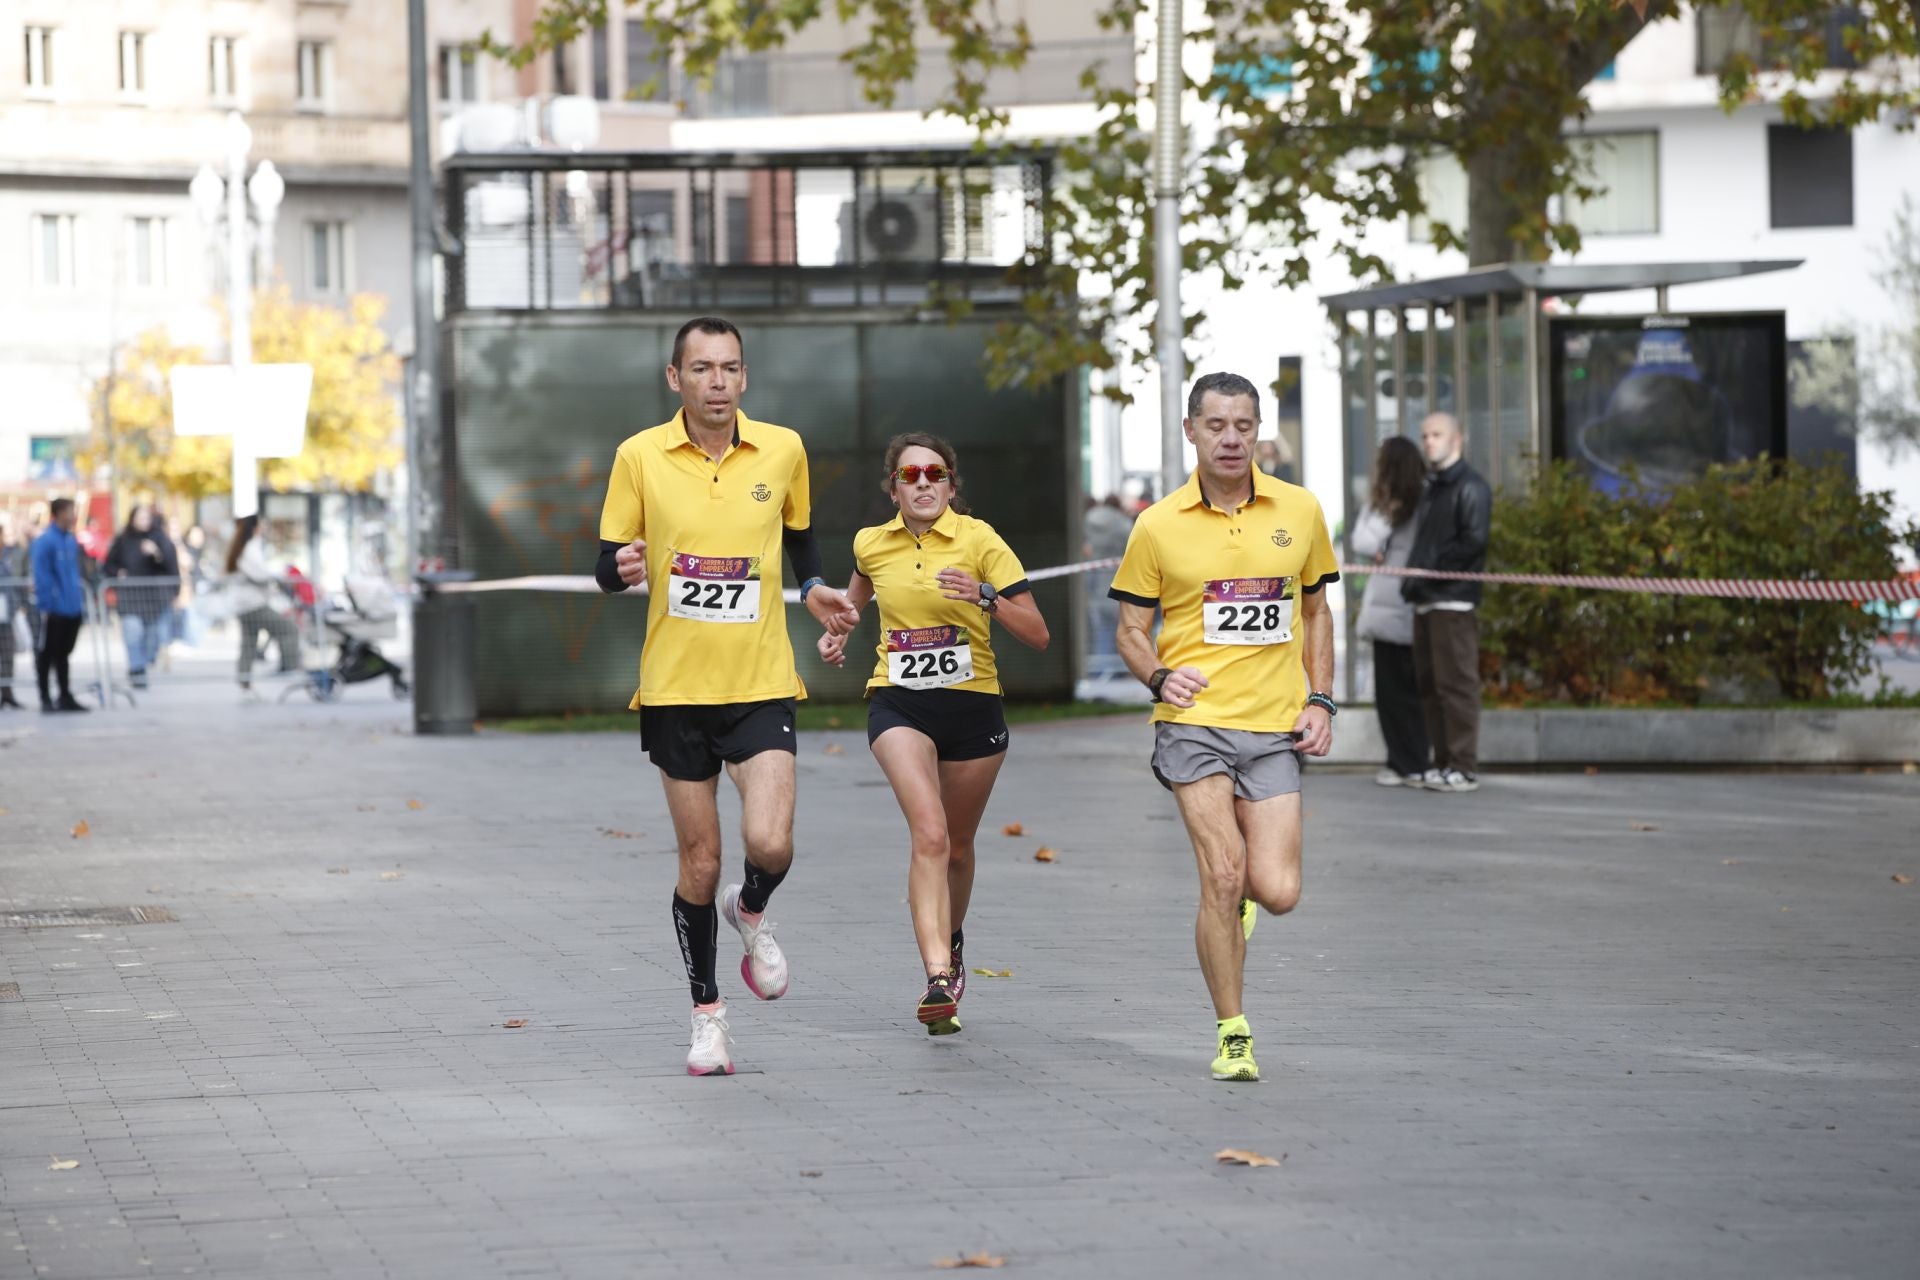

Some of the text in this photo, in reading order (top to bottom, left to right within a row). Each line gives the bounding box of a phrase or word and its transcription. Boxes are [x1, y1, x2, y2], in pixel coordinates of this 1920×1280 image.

[700, 565, 733, 573] EMPRESAS
[1234, 580, 1260, 588] CARRERA
[1234, 586, 1269, 594] EMPRESAS
[680, 581, 746, 609] 227
[1218, 604, 1280, 631] 228
[910, 629, 932, 638] CARRERA
[911, 635, 942, 644] EMPRESAS
[900, 650, 958, 679] 226
